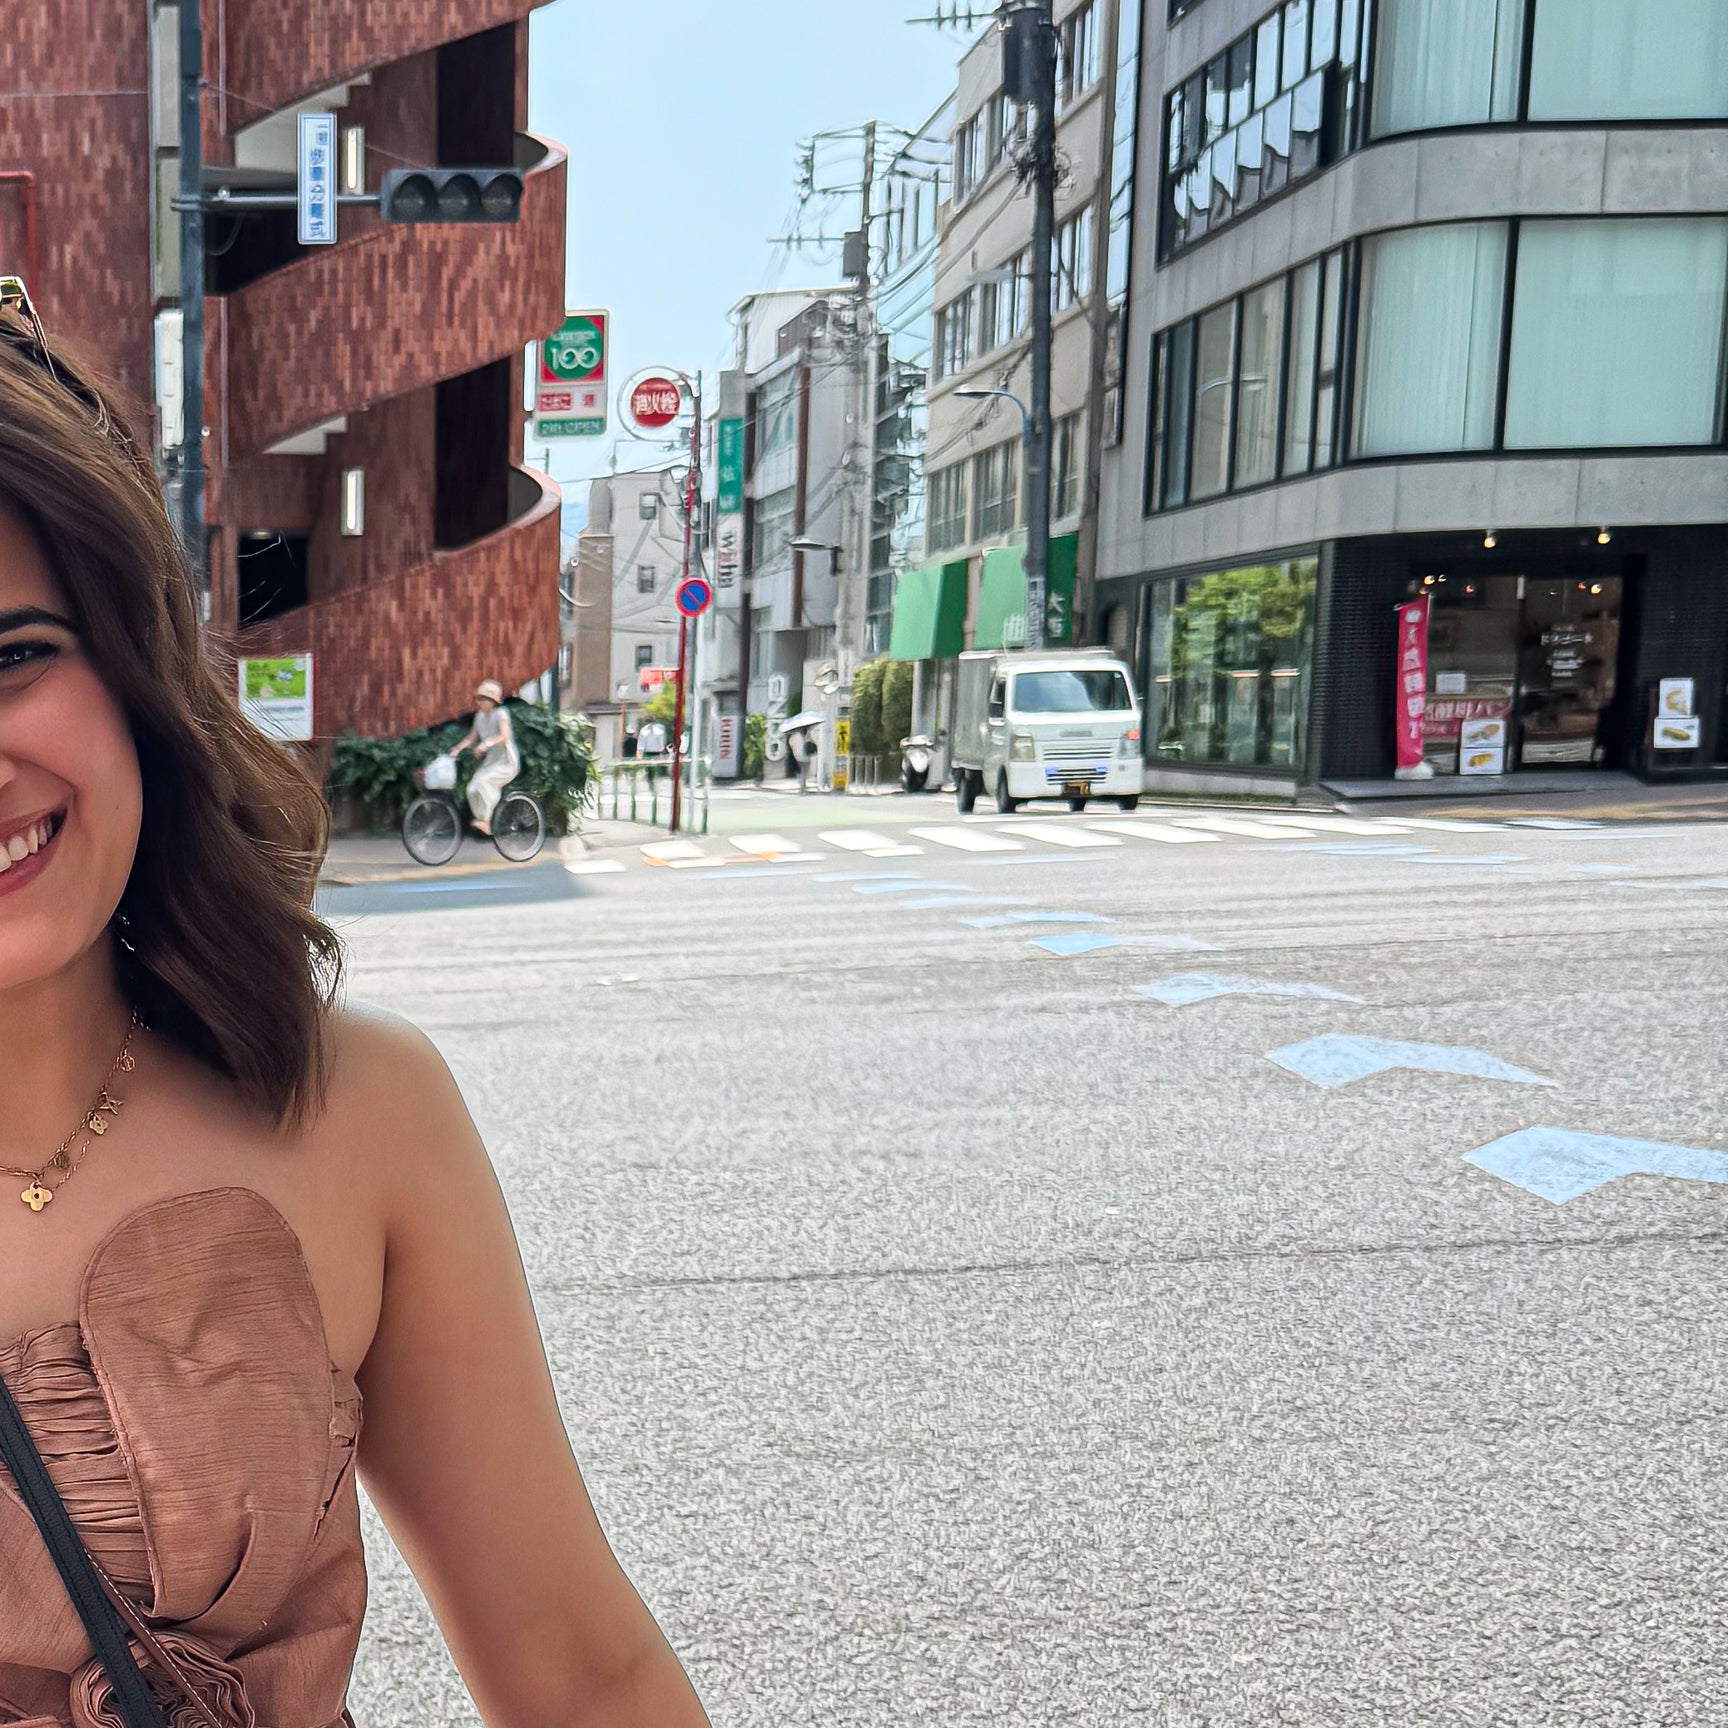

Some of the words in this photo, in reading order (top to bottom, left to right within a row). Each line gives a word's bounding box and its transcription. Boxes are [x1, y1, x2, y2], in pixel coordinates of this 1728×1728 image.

[550, 346, 599, 371] 100
[634, 391, 679, 415] 消火栓
